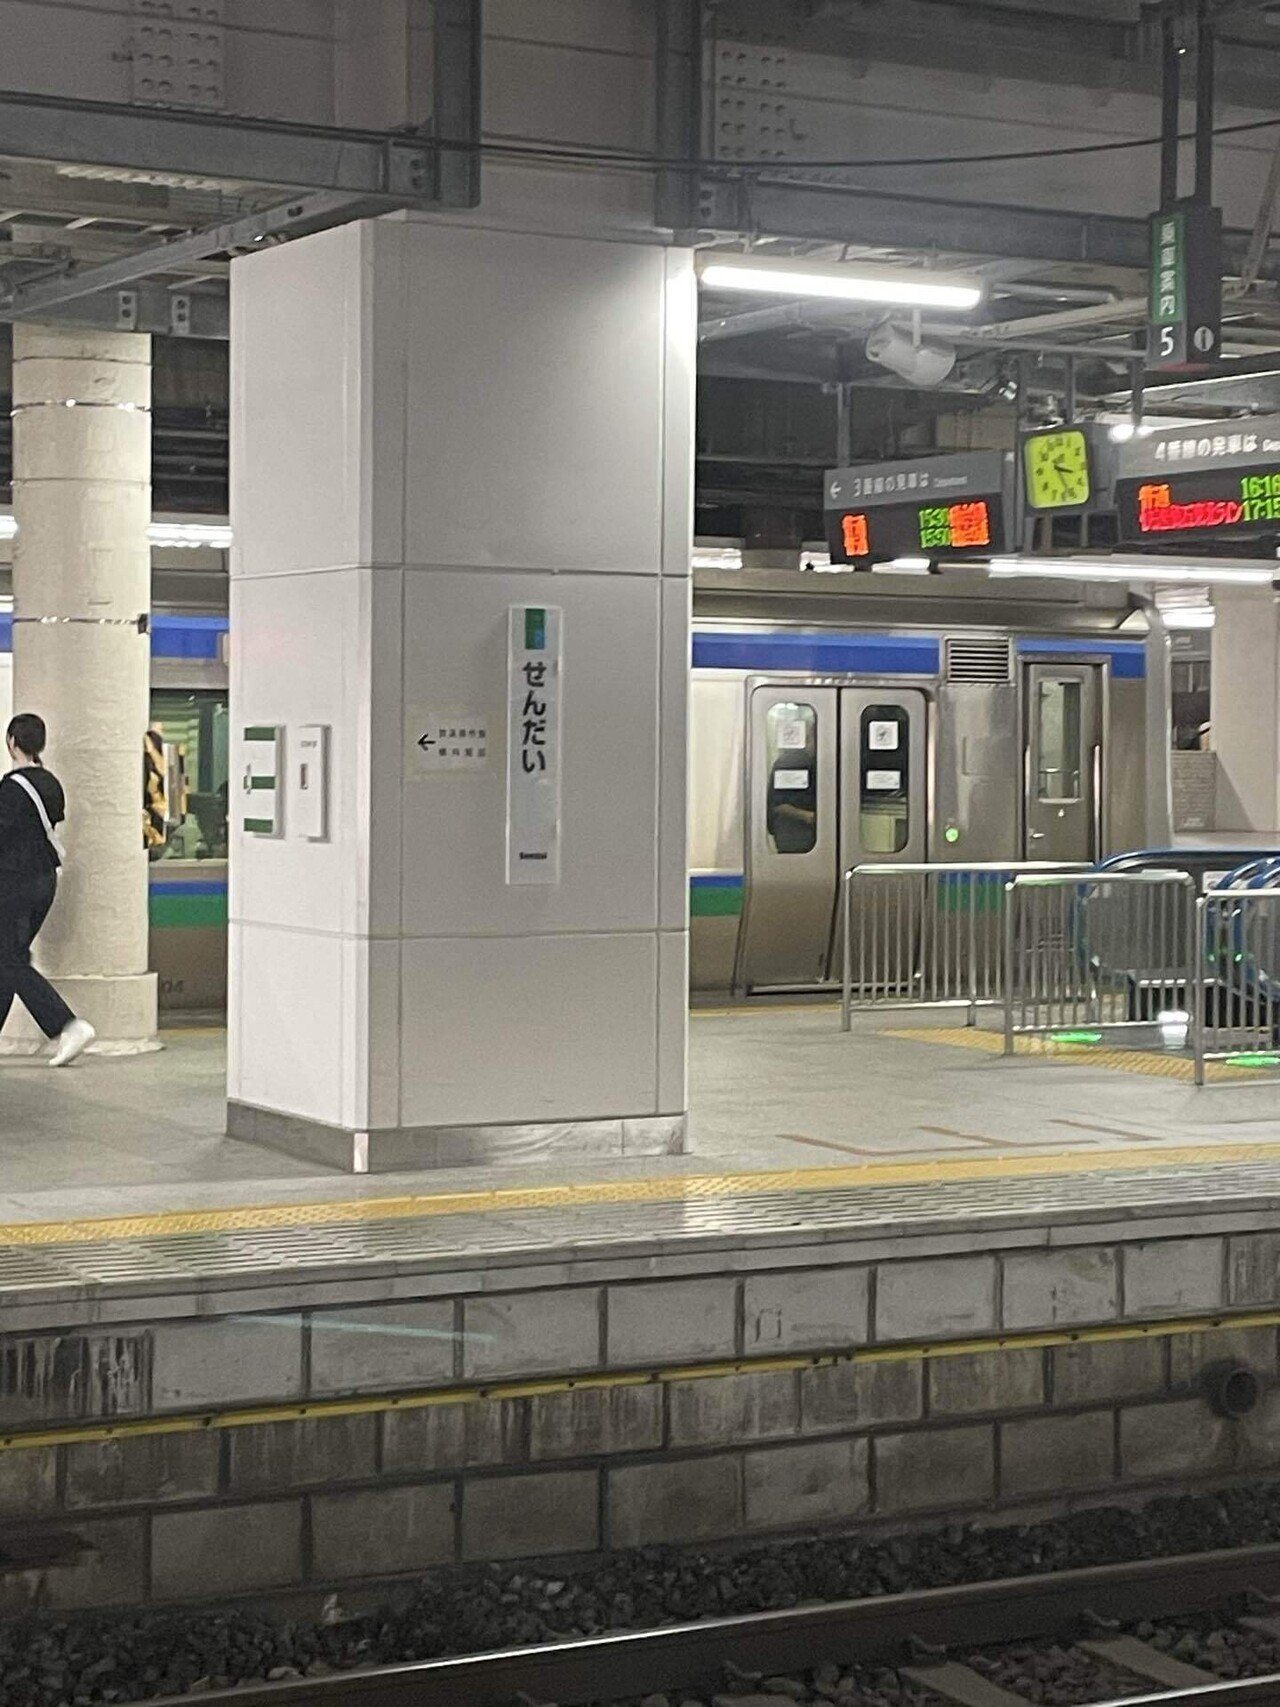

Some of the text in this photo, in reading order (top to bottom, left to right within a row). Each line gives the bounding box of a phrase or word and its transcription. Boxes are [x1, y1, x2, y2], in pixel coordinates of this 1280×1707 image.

[1160, 326, 1175, 357] 5
[522, 661, 547, 774] せんだい
